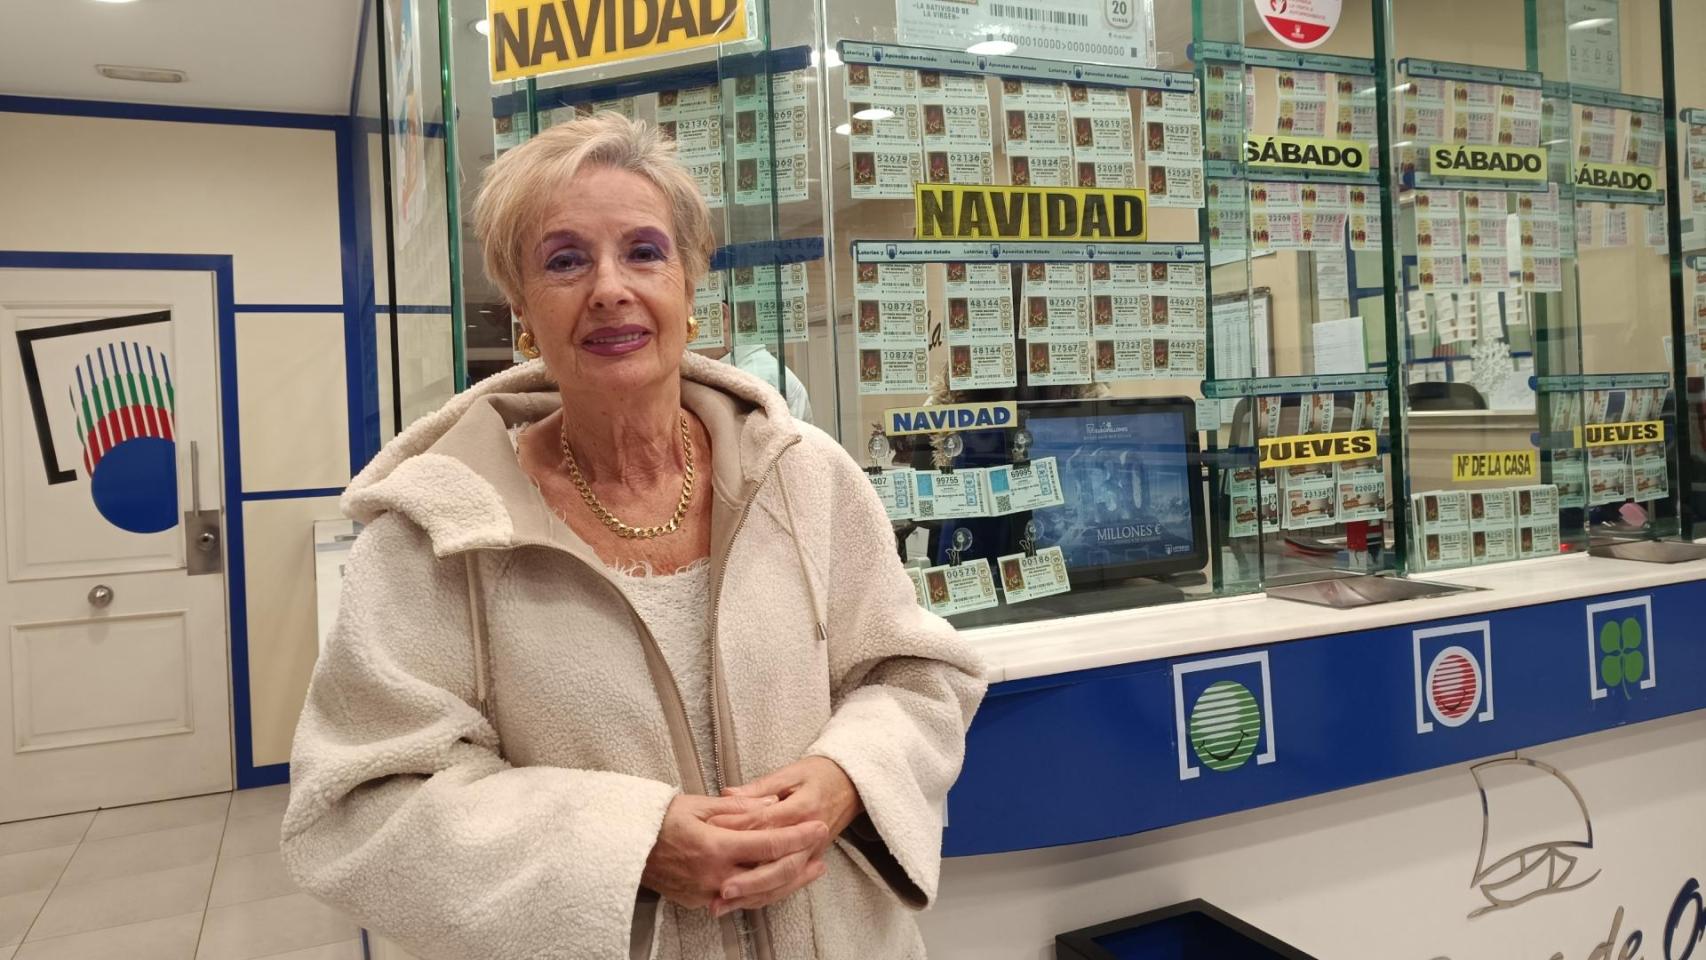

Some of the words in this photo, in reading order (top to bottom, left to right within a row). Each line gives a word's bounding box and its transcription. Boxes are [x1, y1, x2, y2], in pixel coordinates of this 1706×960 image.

[1112, 1, 1127, 15] 20
[493, 0, 740, 72] NAVIDAD
[1246, 137, 1363, 169] SÁBADO
[1435, 146, 1542, 172] SÁBADO
[1574, 163, 1653, 190] ÁBADO
[921, 190, 1144, 237] NAVIDAD
[881, 302, 912, 312] 10872
[970, 299, 999, 307] 48144
[884, 351, 914, 360] 10872
[973, 346, 1001, 354] 48144
[893, 406, 1011, 432] NAVIDAD
[1472, 455, 1486, 476] DE
[1488, 455, 1502, 476] LA
[1504, 454, 1531, 475] CASA
[1097, 524, 1152, 541] MILLONES
[1154, 521, 1161, 535] €
[1021, 554, 1050, 567] 00186
